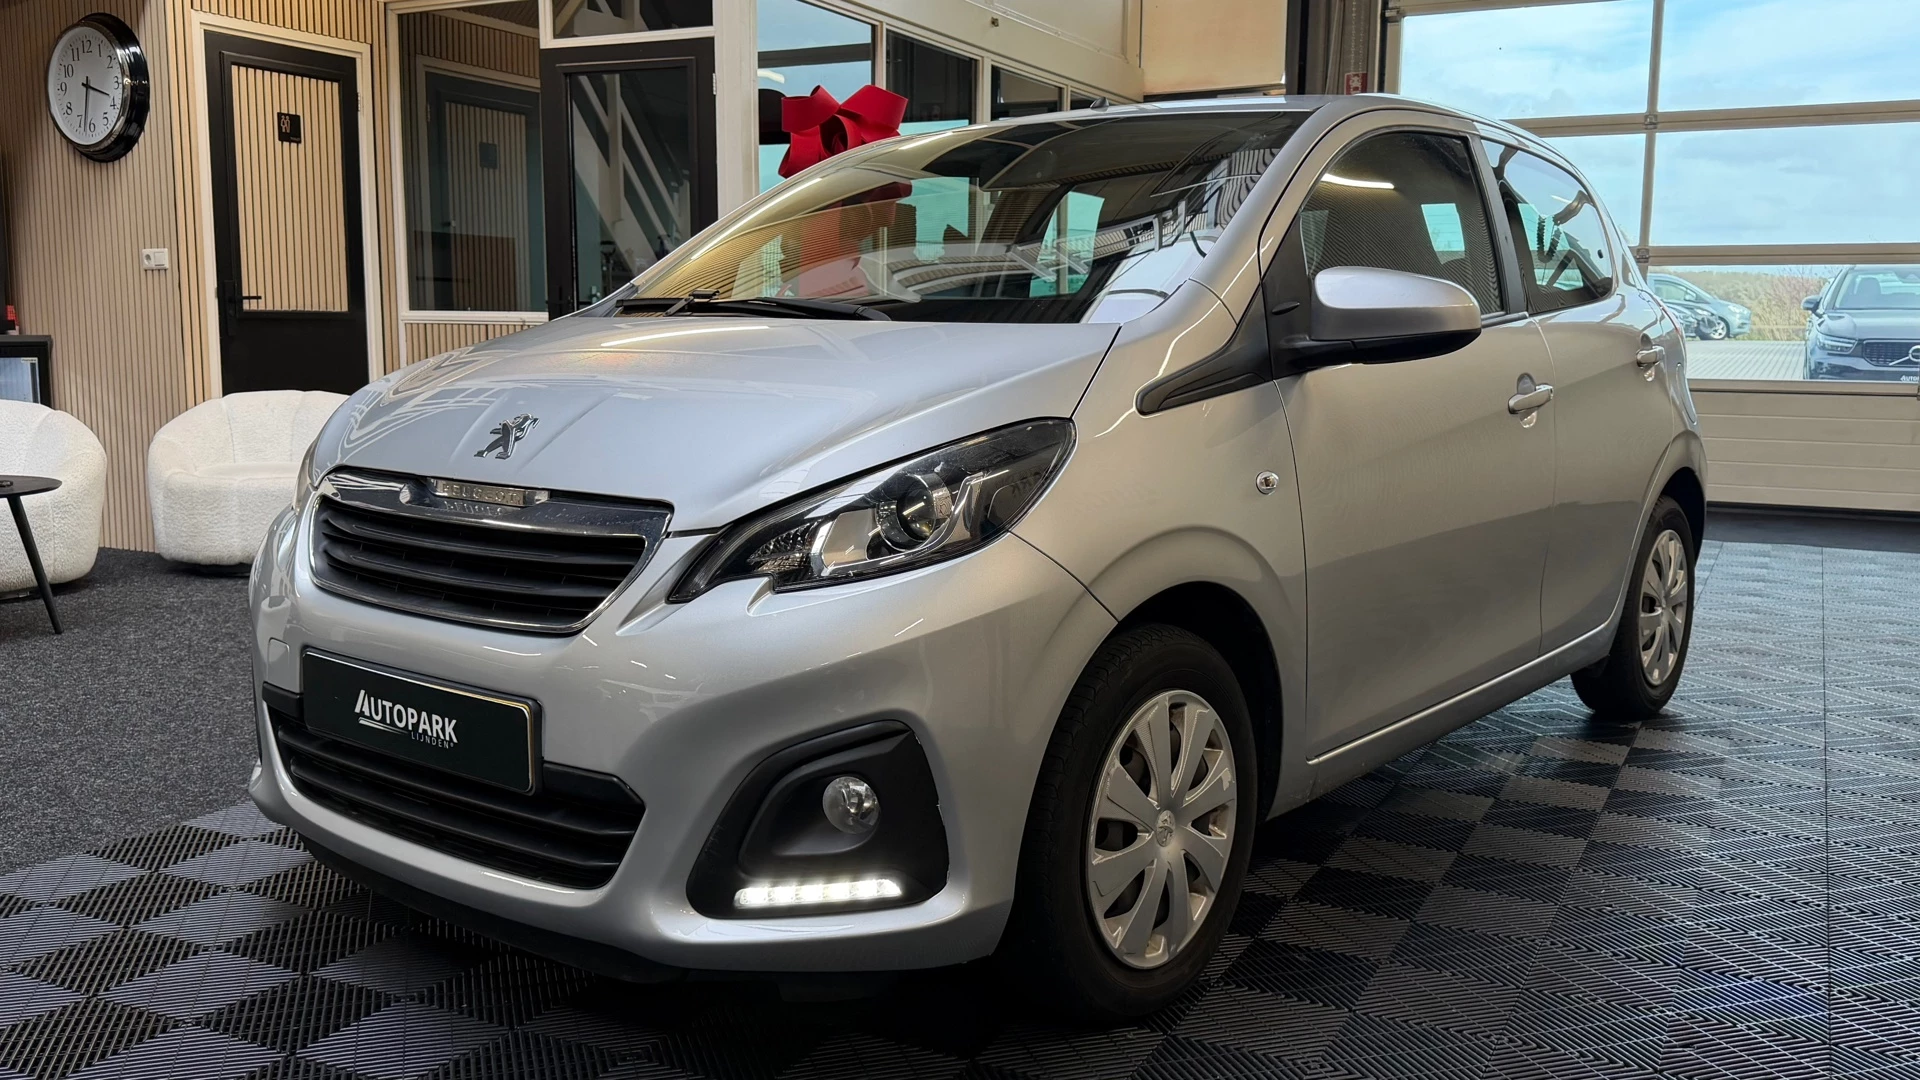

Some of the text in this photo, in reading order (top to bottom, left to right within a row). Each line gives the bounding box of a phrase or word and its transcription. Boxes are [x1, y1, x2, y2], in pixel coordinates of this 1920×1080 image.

[81, 40, 92, 53] 12
[98, 44, 102, 57] 1
[71, 47, 80, 61] 11
[107, 55, 113, 69] 2
[63, 64, 74, 78] 10
[60, 82, 67, 96] 9
[113, 76, 120, 90] 3
[66, 102, 73, 115] 8
[110, 96, 117, 110] 4
[77, 115, 83, 128] 7
[89, 118, 96, 132] 6
[102, 112, 109, 126] 5
[354, 689, 458, 743] AUTOPARK
